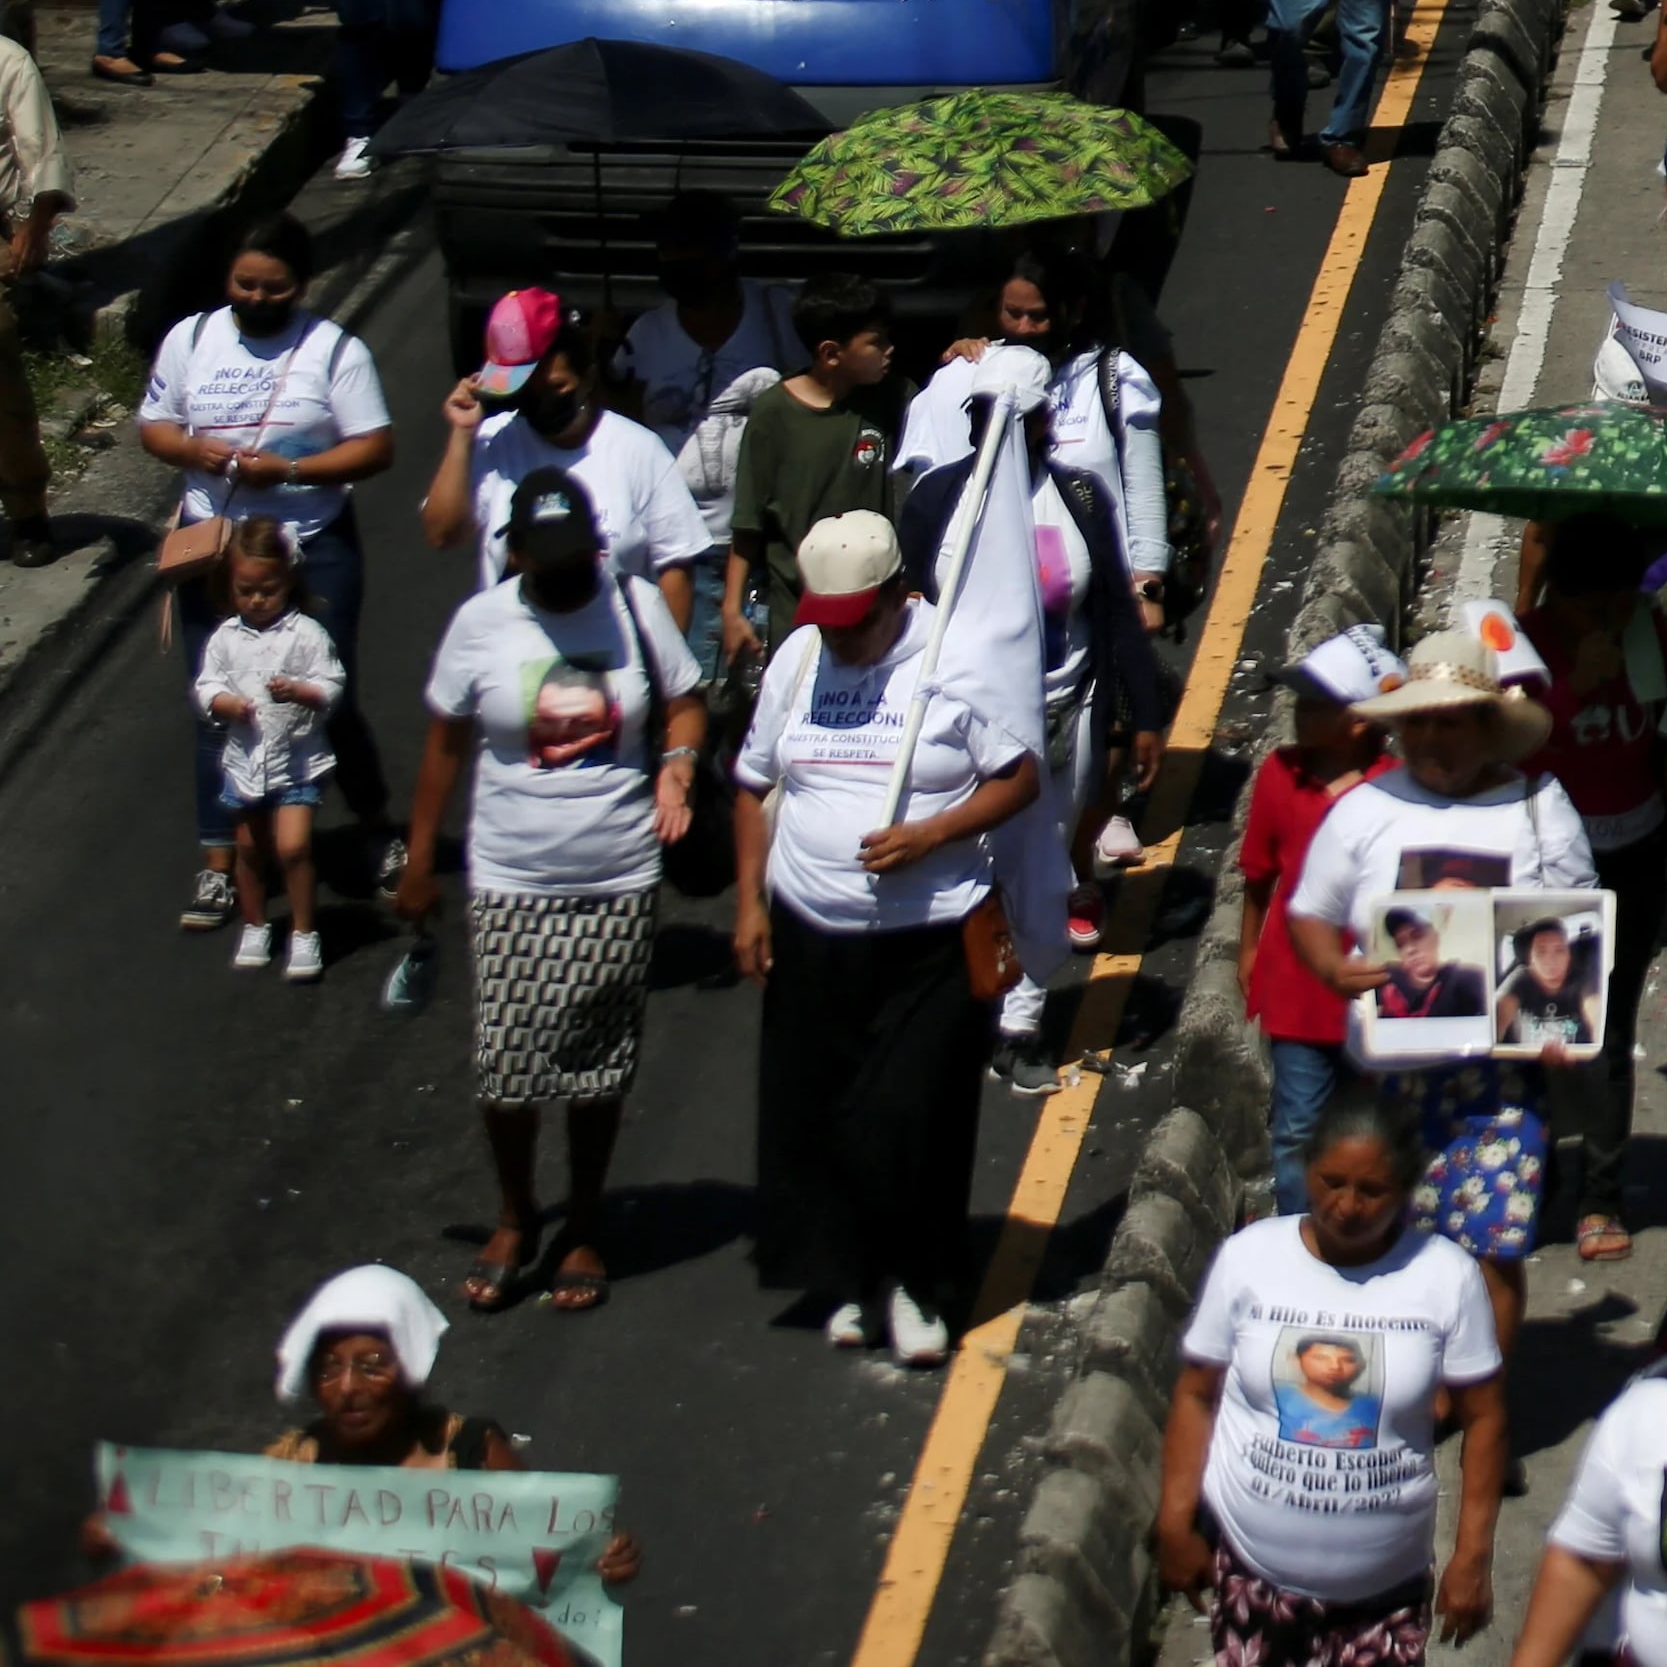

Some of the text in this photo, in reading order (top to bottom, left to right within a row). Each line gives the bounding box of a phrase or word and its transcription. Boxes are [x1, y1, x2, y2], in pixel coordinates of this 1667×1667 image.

[1638, 348, 1662, 366] BRP
[817, 690, 849, 709] ¡NO
[850, 690, 862, 705] A
[812, 747, 825, 759] SE
[1268, 1306, 1431, 1332] Hijo Es Inocente
[1250, 1451, 1297, 1484] quiero
[1302, 1473, 1338, 1493] que
[1344, 1473, 1362, 1492] lo
[1335, 1449, 1402, 1472] Escobar
[147, 1468, 518, 1532] LIBERTAD PARA
